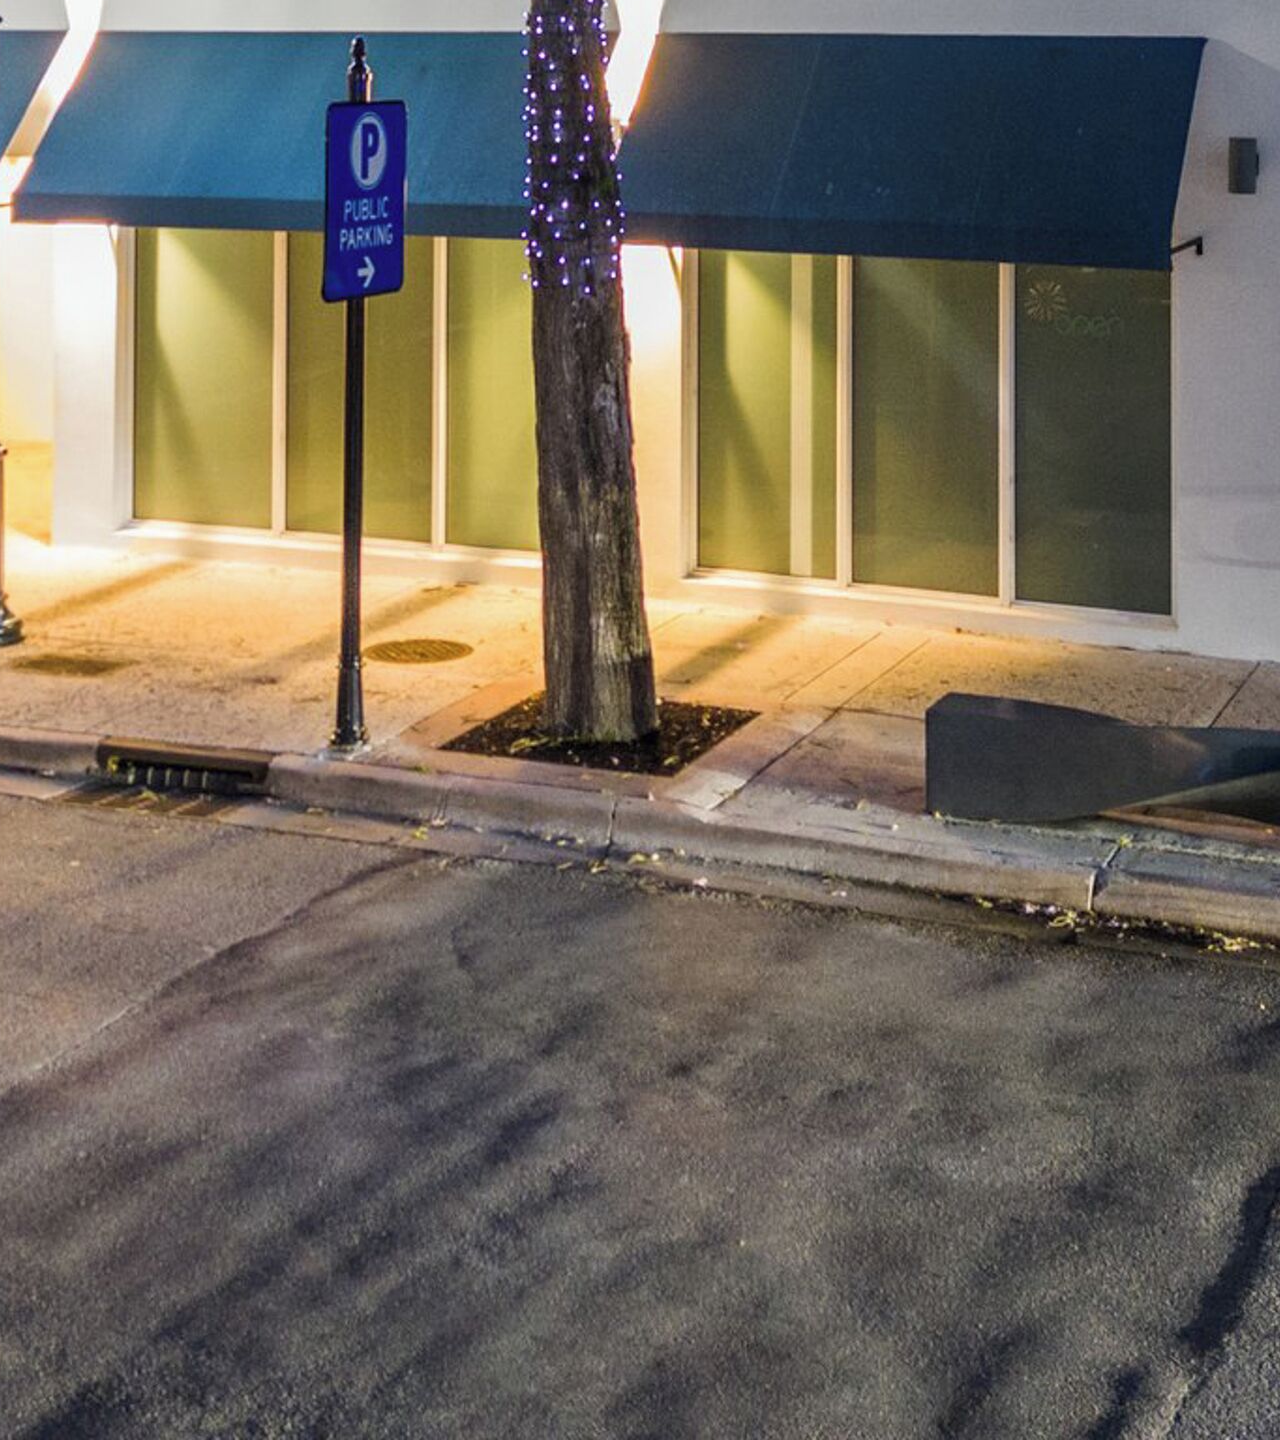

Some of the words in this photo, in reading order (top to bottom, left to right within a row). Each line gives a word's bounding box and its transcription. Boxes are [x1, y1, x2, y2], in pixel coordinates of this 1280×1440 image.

[360, 122, 380, 181] P
[343, 196, 389, 225] PUBLIC
[338, 224, 393, 252] PARKING
